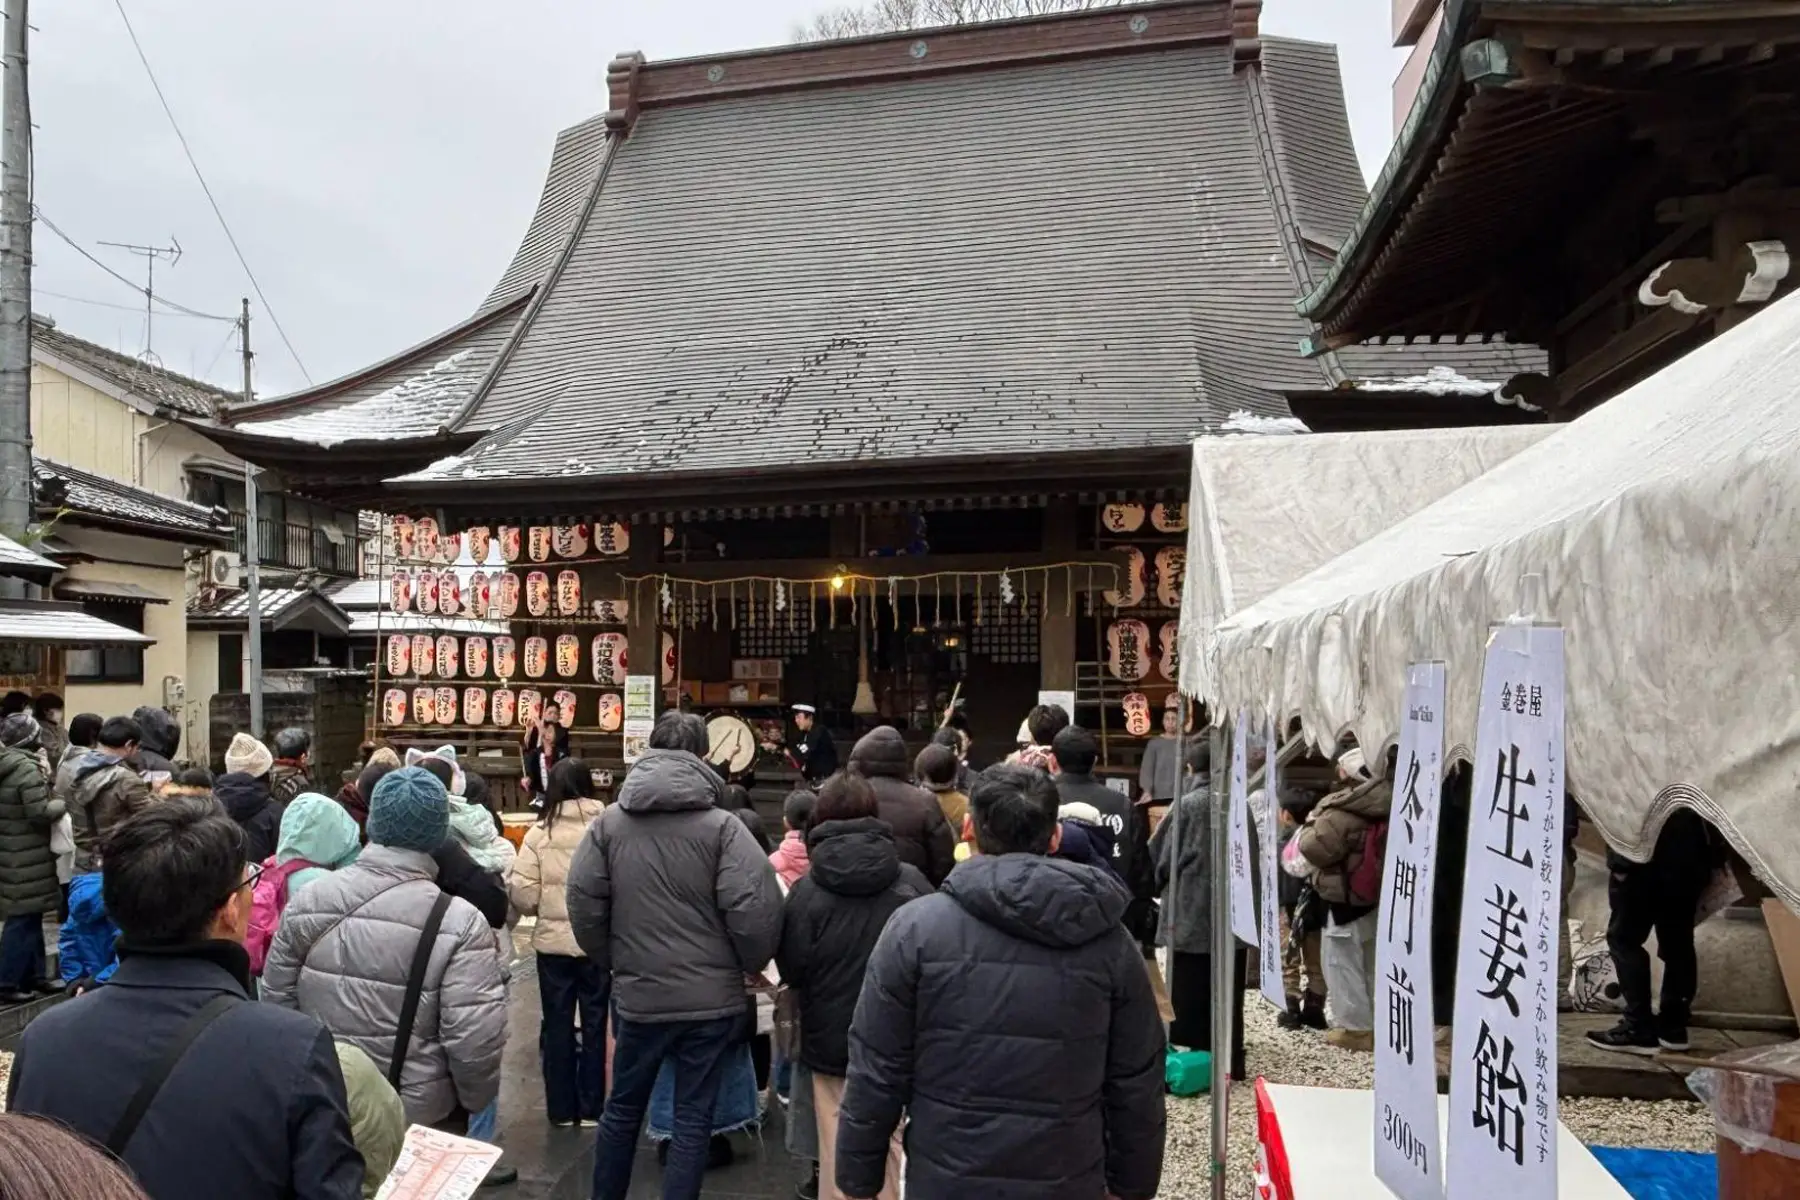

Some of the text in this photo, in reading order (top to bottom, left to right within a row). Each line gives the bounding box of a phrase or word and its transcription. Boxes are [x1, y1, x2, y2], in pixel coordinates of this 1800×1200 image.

[1471, 743, 1536, 1166] 生姜飴
[1383, 1103, 1427, 1176] 300円
